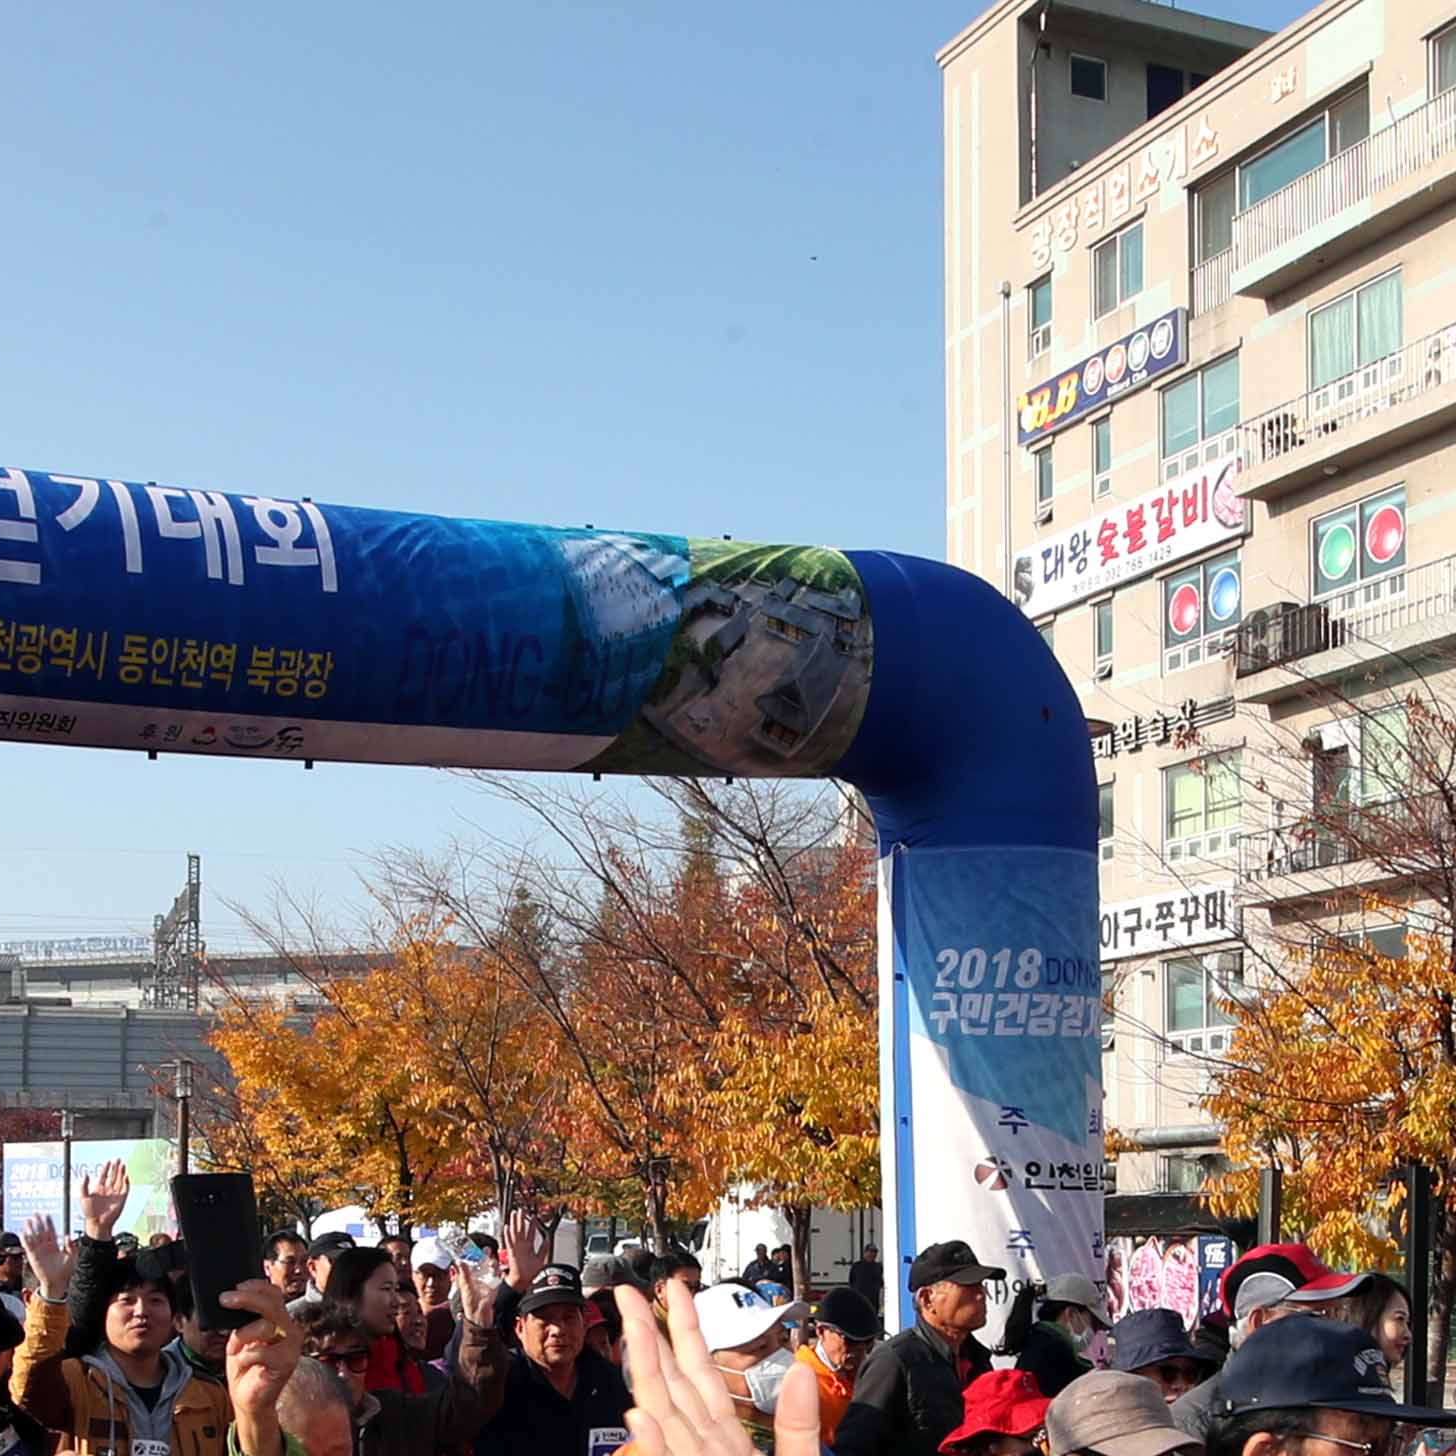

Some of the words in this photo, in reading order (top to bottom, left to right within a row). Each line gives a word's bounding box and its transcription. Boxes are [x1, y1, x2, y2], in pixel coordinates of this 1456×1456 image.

[1041, 530, 1092, 584] 대왕
[1096, 476, 1208, 567] 숯불갈비
[118, 636, 238, 692] 동인천역
[247, 647, 334, 698] 북광장
[935, 947, 1043, 989] 2018
[998, 1106, 1029, 1135] 주
[1024, 1161, 1104, 1190] 인천일
